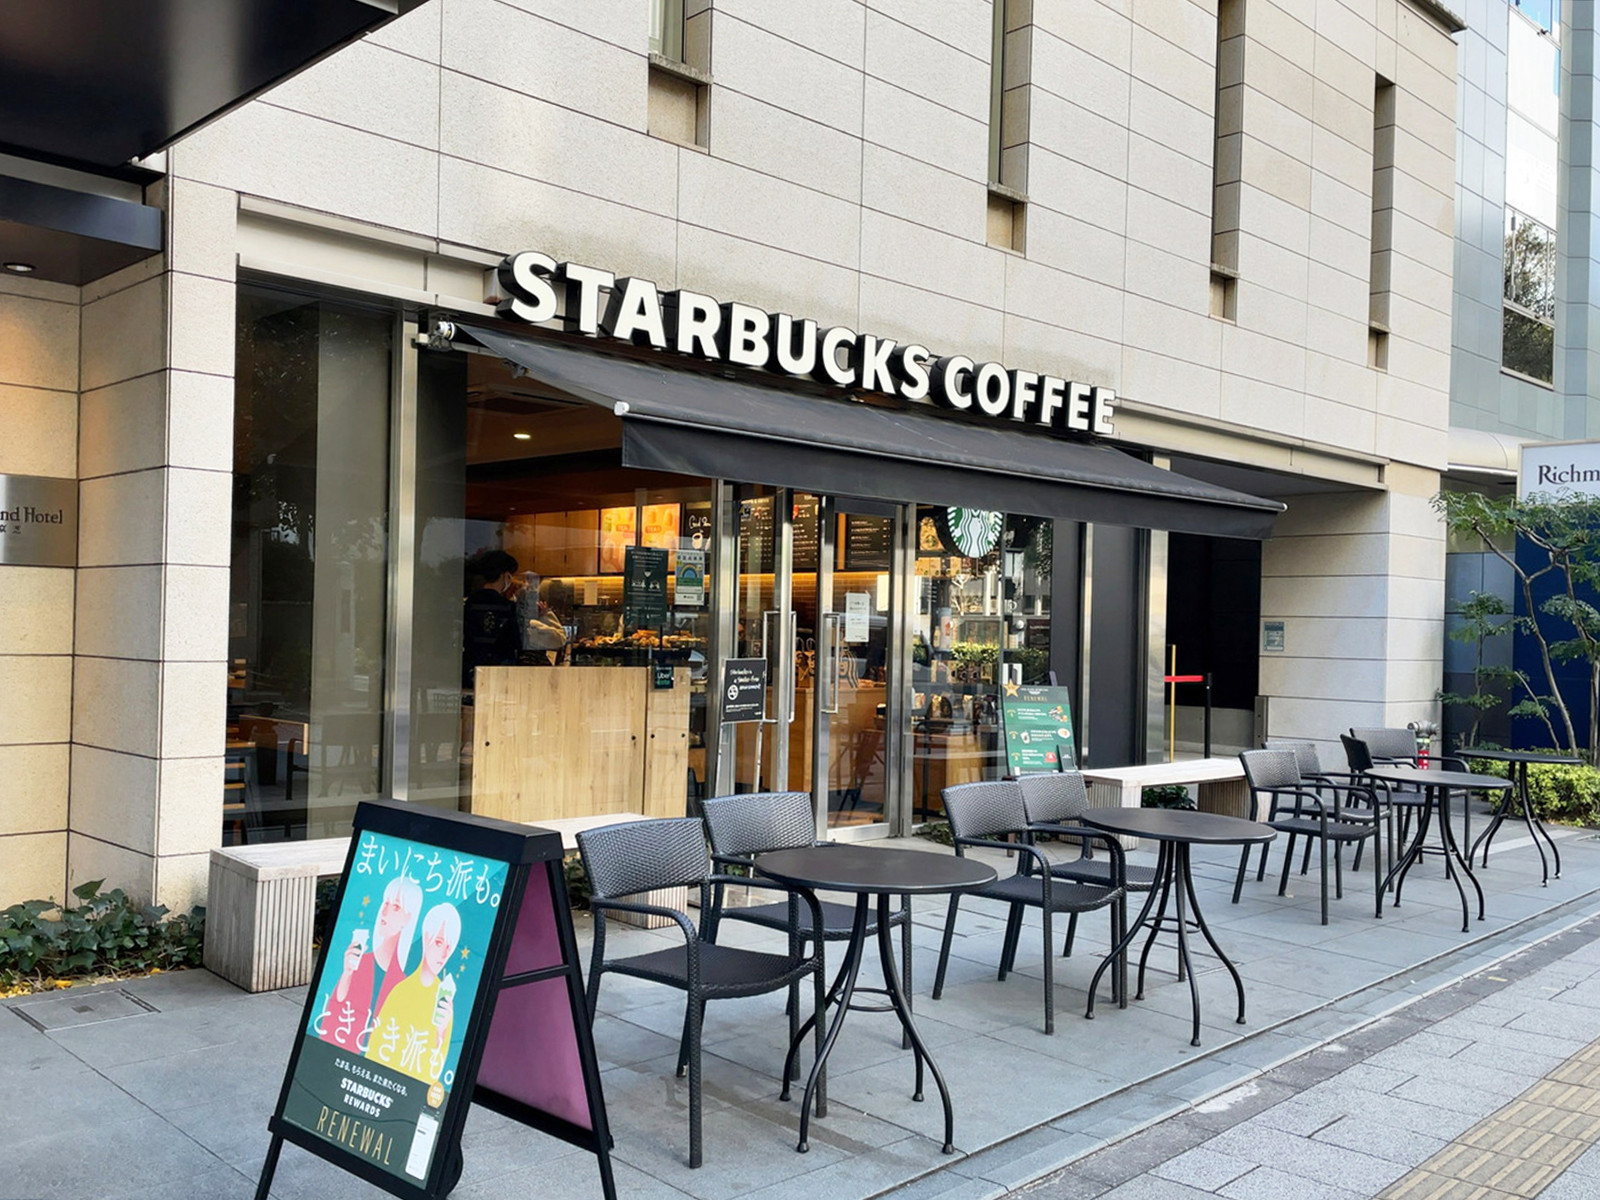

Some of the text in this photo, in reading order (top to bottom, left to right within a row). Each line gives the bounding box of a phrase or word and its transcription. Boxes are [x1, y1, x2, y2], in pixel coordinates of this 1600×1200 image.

[509, 249, 1116, 436] STARBUCKS COFFEE
[1538, 463, 1600, 485] Richm
[23, 506, 63, 524] Hotel
[356, 835, 500, 908] まいにち派も。
[313, 993, 454, 1085] ときどき派も。
[339, 1077, 394, 1109] STARBUCKS
[343, 1094, 381, 1118] REWARDS
[316, 1105, 394, 1166] RENEWAL
